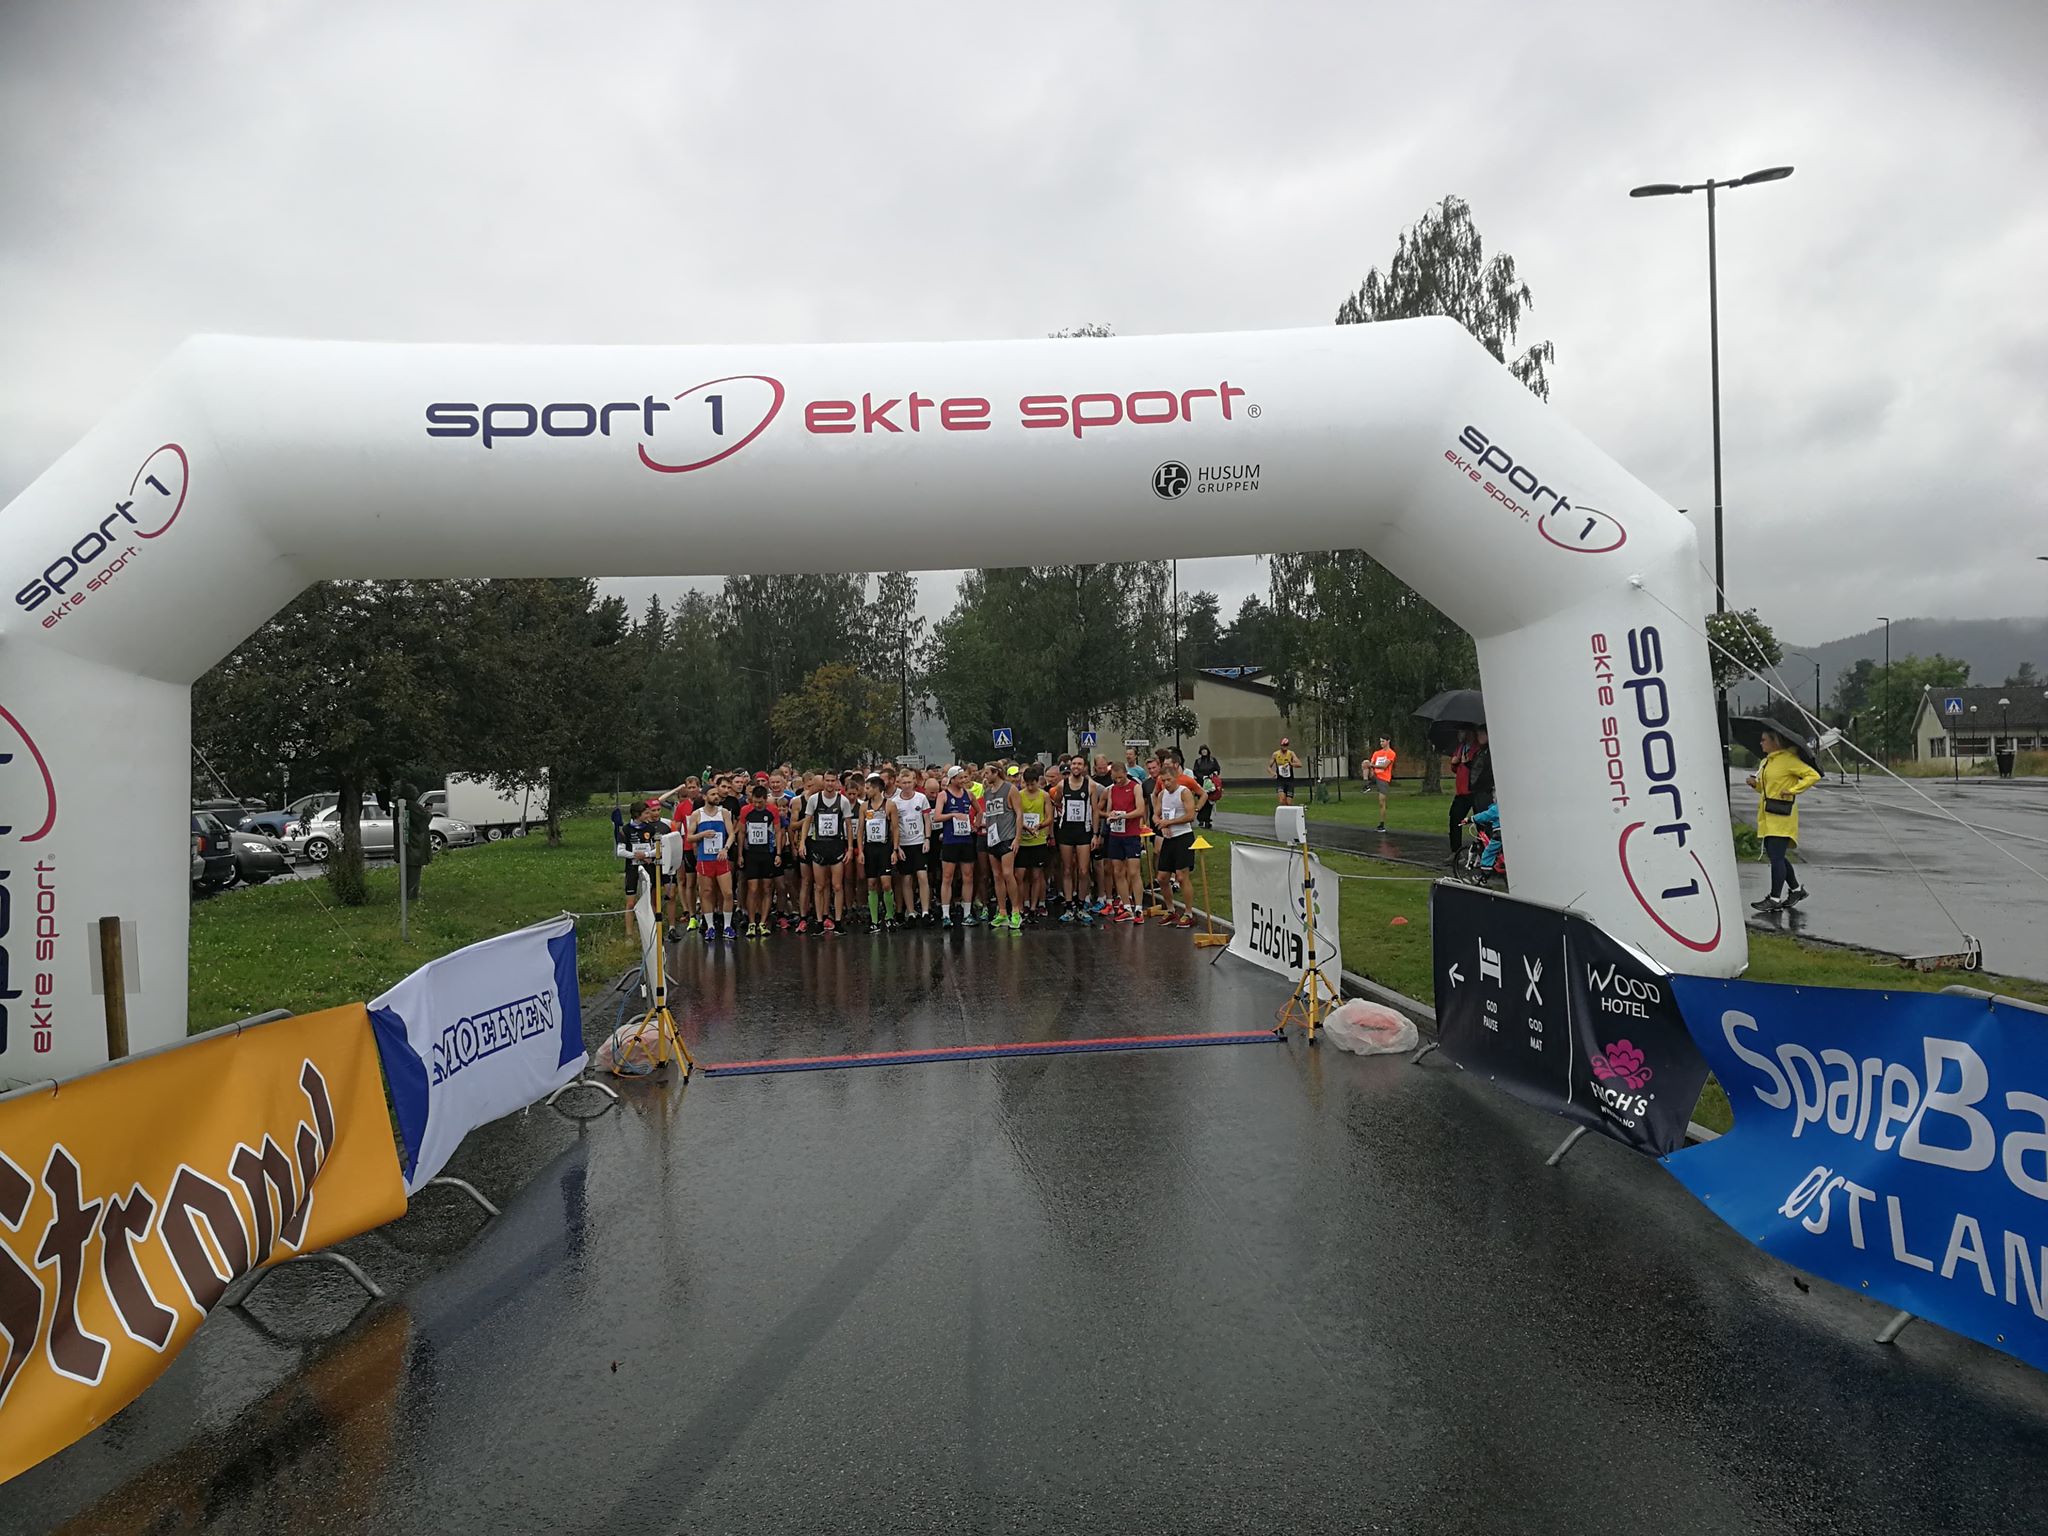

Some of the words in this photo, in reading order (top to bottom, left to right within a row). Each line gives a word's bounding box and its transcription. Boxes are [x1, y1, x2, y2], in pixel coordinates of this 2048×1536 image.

[426, 396, 670, 449] sport
[705, 395, 723, 435] 1
[805, 391, 991, 434] ekte
[1020, 381, 1245, 438] sport
[1197, 480, 1259, 493] GRUPPEN
[1198, 464, 1260, 481] HUSUM
[1444, 449, 1482, 482] ekte
[1482, 481, 1530, 519] sport
[1459, 425, 1571, 516] sport
[1579, 517, 1597, 540] 1
[15, 501, 138, 612] sport
[145, 474, 171, 496] 1
[42, 592, 86, 629] ekte
[86, 546, 137, 592] sport
[1591, 633, 1615, 706] ekte
[1600, 716, 1630, 807] sport
[1622, 626, 1692, 848] sport
[1661, 878, 1699, 899] 1
[752, 830, 763, 838] 101
[824, 822, 833, 830] 22
[871, 826, 880, 834] 92
[908, 822, 917, 830] 70
[33, 860, 60, 960] sport
[30, 973, 53, 1053] ekte
[1483, 1015, 1498, 1032] PAUSE
[1486, 1000, 1497, 1013] GOD
[1528, 1017, 1543, 1033] GOD
[1601, 997, 1650, 1019] HOTEL
[432, 990, 554, 1086] MOELVEN
[1530, 1036, 1542, 1052] MAT
